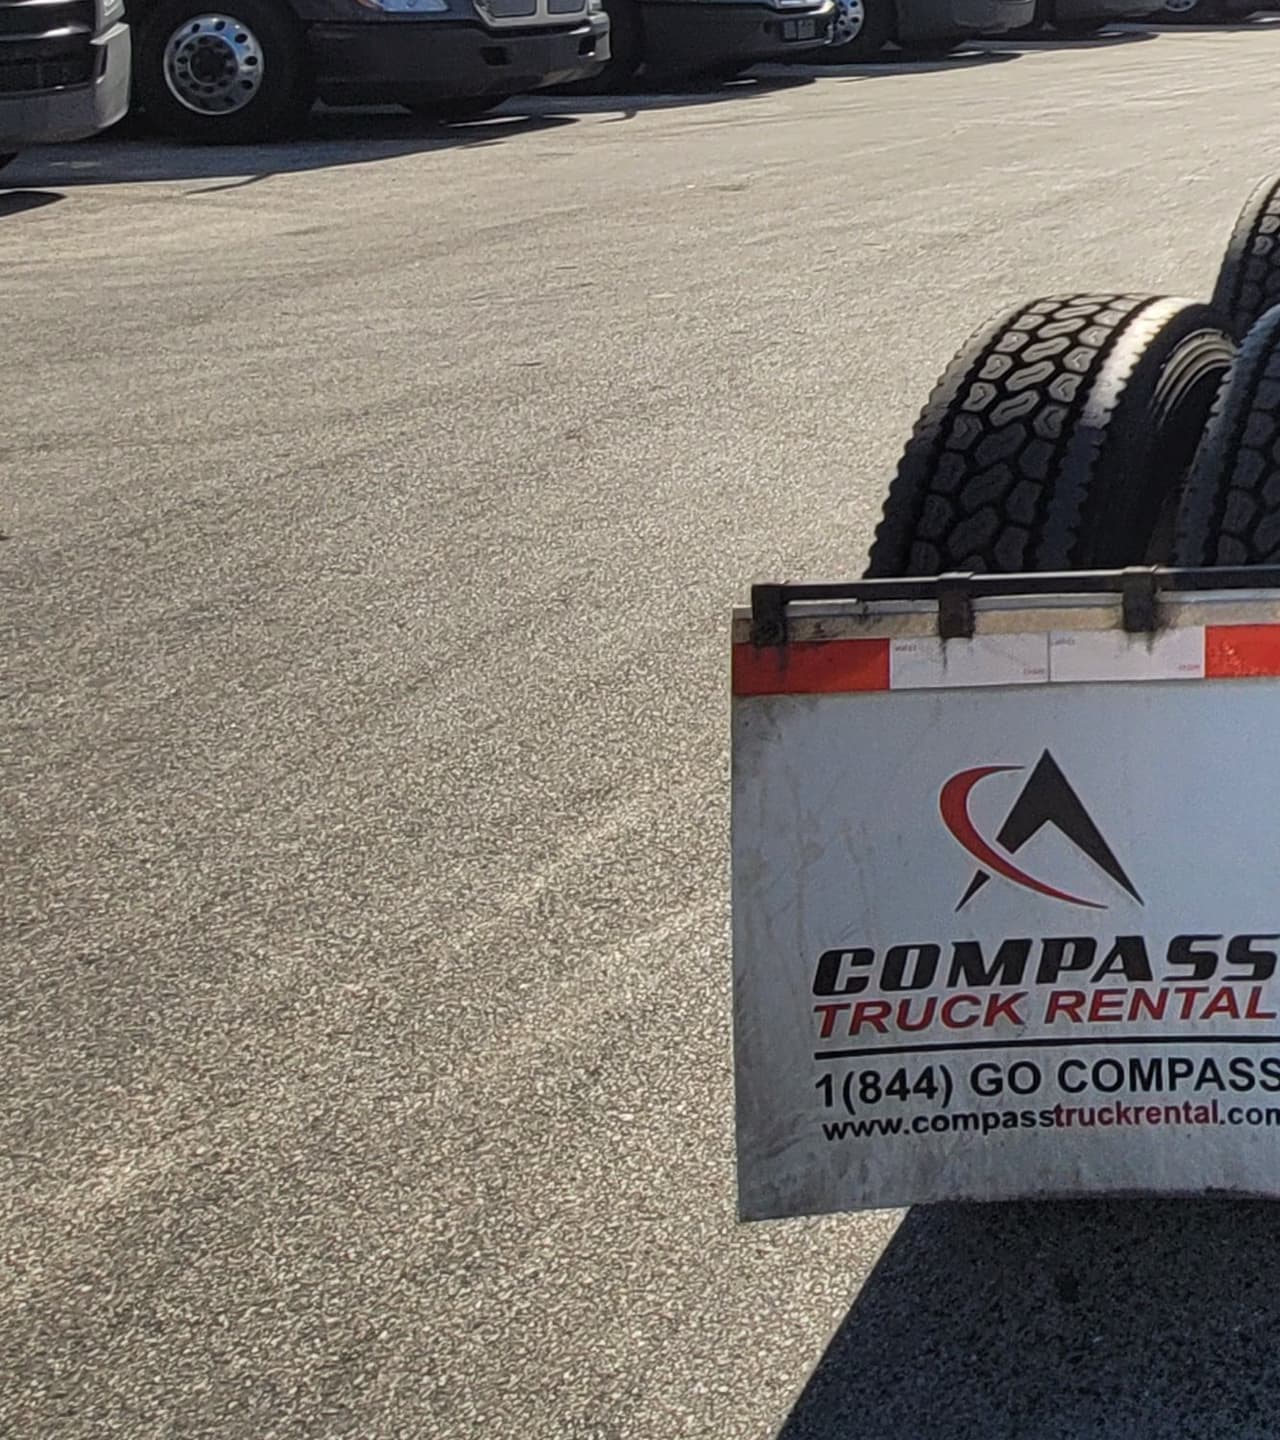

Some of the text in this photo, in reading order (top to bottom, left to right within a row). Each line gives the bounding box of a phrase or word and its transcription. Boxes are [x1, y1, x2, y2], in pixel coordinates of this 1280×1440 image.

[813, 986, 1278, 1039] TRUCK RENTAL
[815, 1064, 953, 1116] 1(844)
[970, 1061, 1042, 1097] GO
